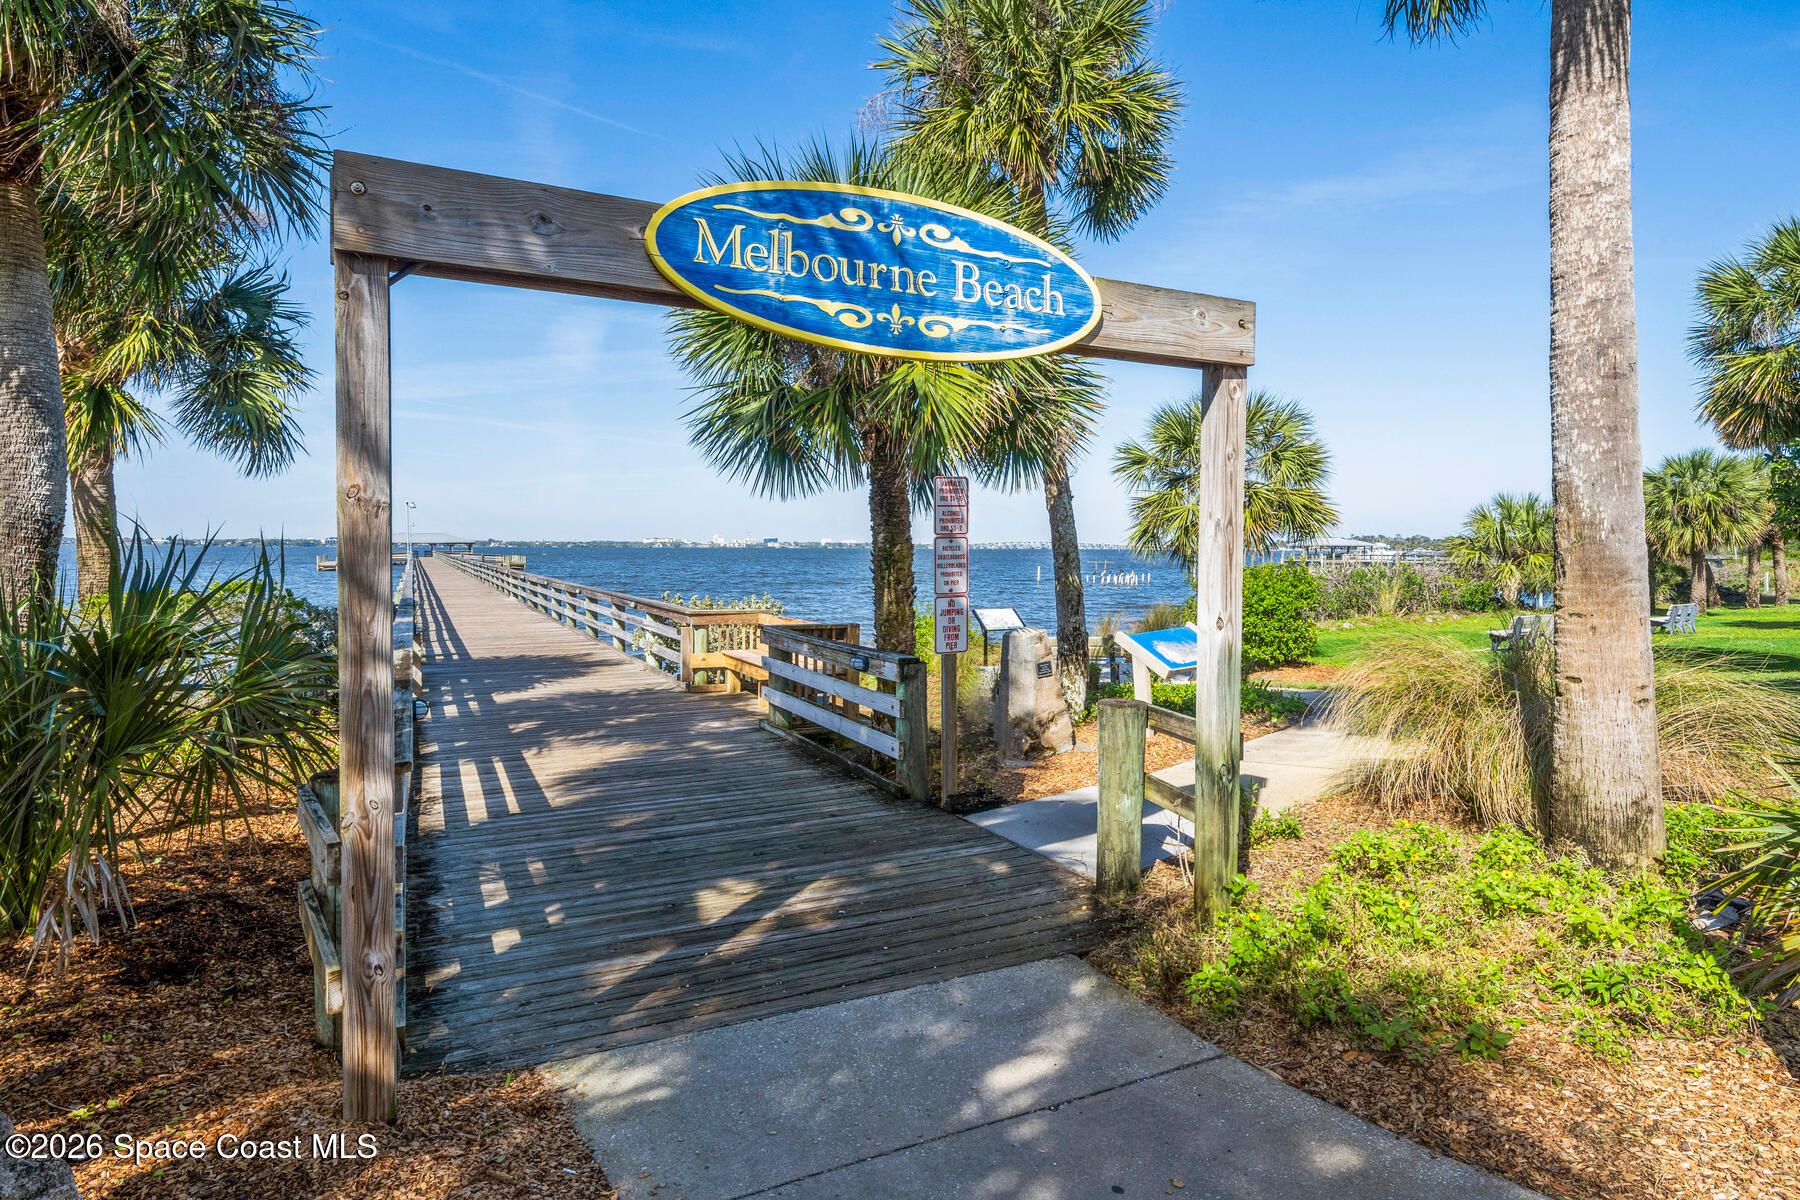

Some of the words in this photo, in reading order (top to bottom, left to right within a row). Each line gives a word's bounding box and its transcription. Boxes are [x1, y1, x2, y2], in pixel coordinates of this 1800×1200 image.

[693, 217, 937, 297] Melbourne
[953, 260, 1066, 317] Beach
[940, 608, 963, 616] JUMPING
[944, 633, 959, 641] FROM
